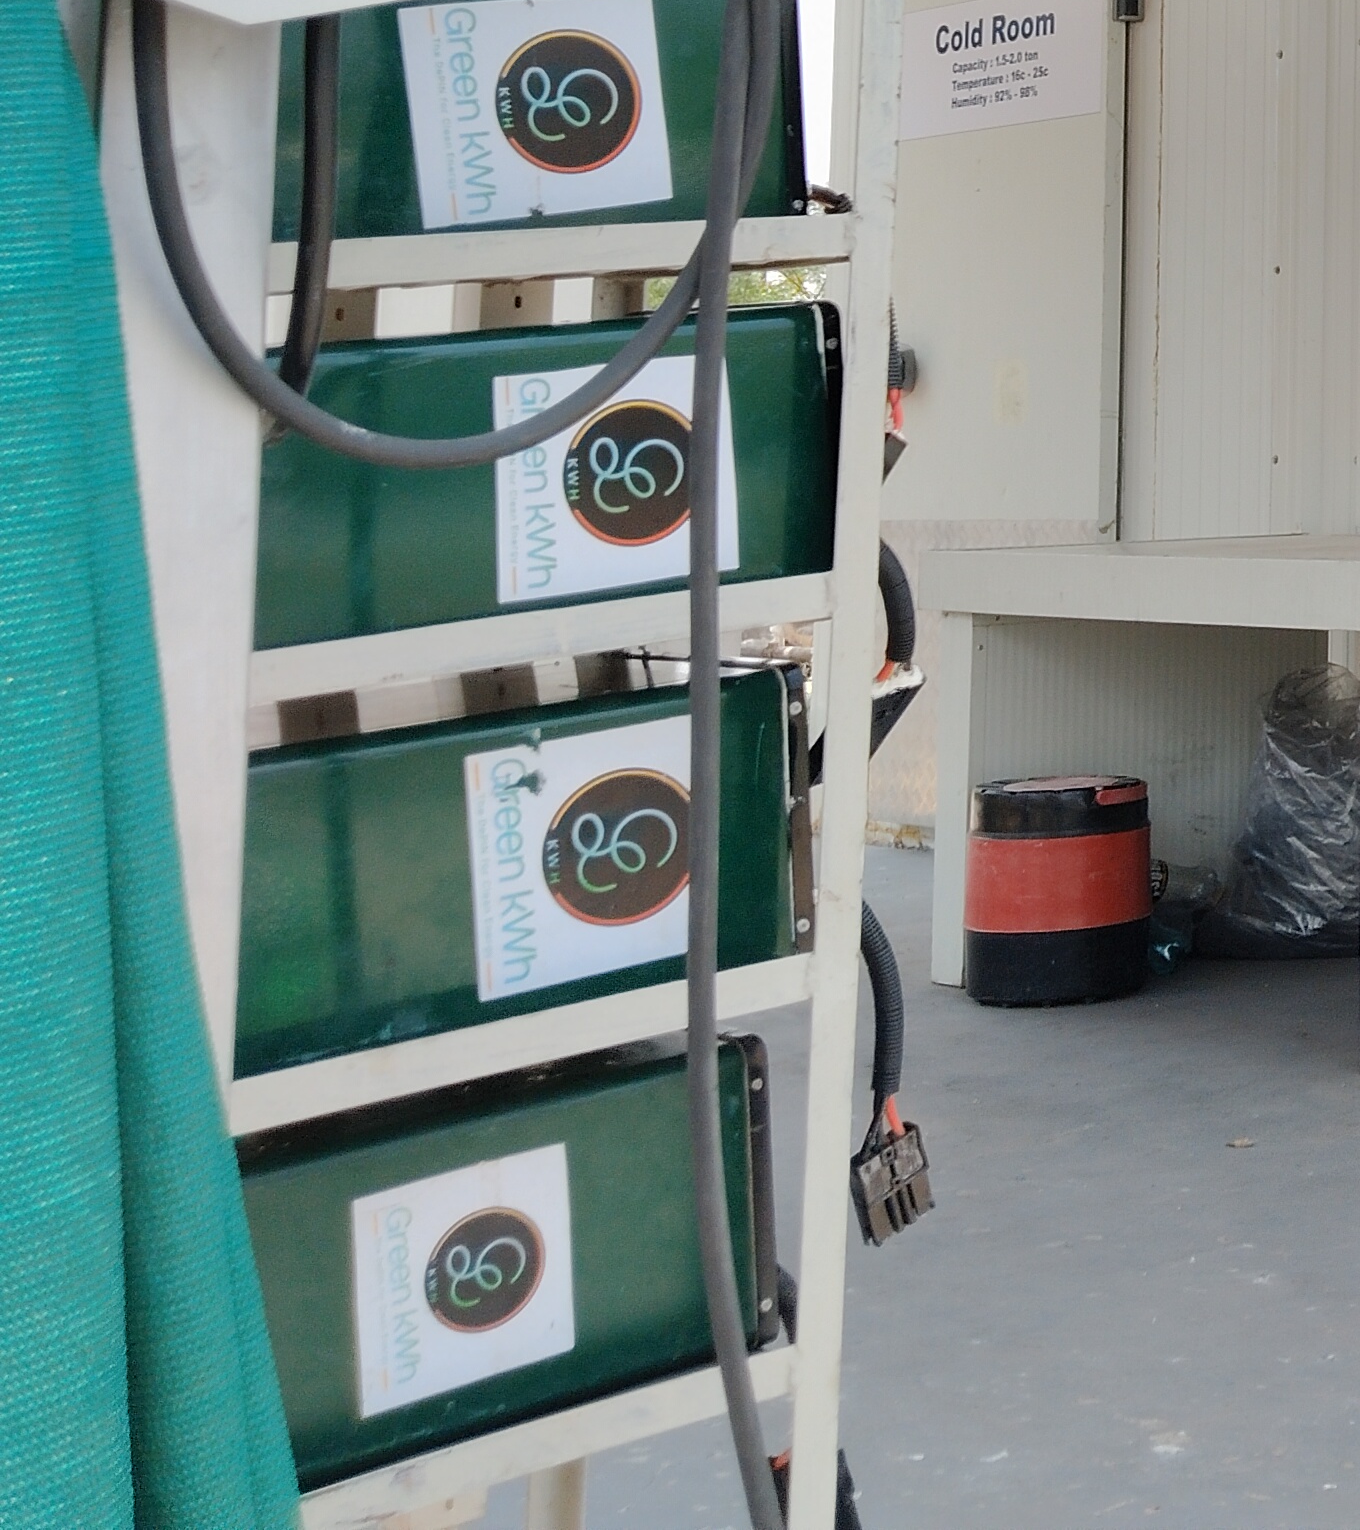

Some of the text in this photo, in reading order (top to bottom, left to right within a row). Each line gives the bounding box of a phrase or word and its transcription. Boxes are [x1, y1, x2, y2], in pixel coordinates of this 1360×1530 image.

[935, 12, 1055, 54] Cold Room
[952, 58, 988, 75] Capacity
[1025, 51, 1038, 62] ton
[952, 75, 1003, 91] Temperature
[444, 7, 497, 216] Green kWh
[499, 86, 515, 130] KWH
[951, 94, 987, 109] Humidity
[519, 377, 558, 590] Gren kWh
[566, 457, 581, 501] KWH
[490, 757, 538, 984] Green kWh
[546, 838, 561, 886] KWH
[385, 1206, 421, 1385] Green kWh
